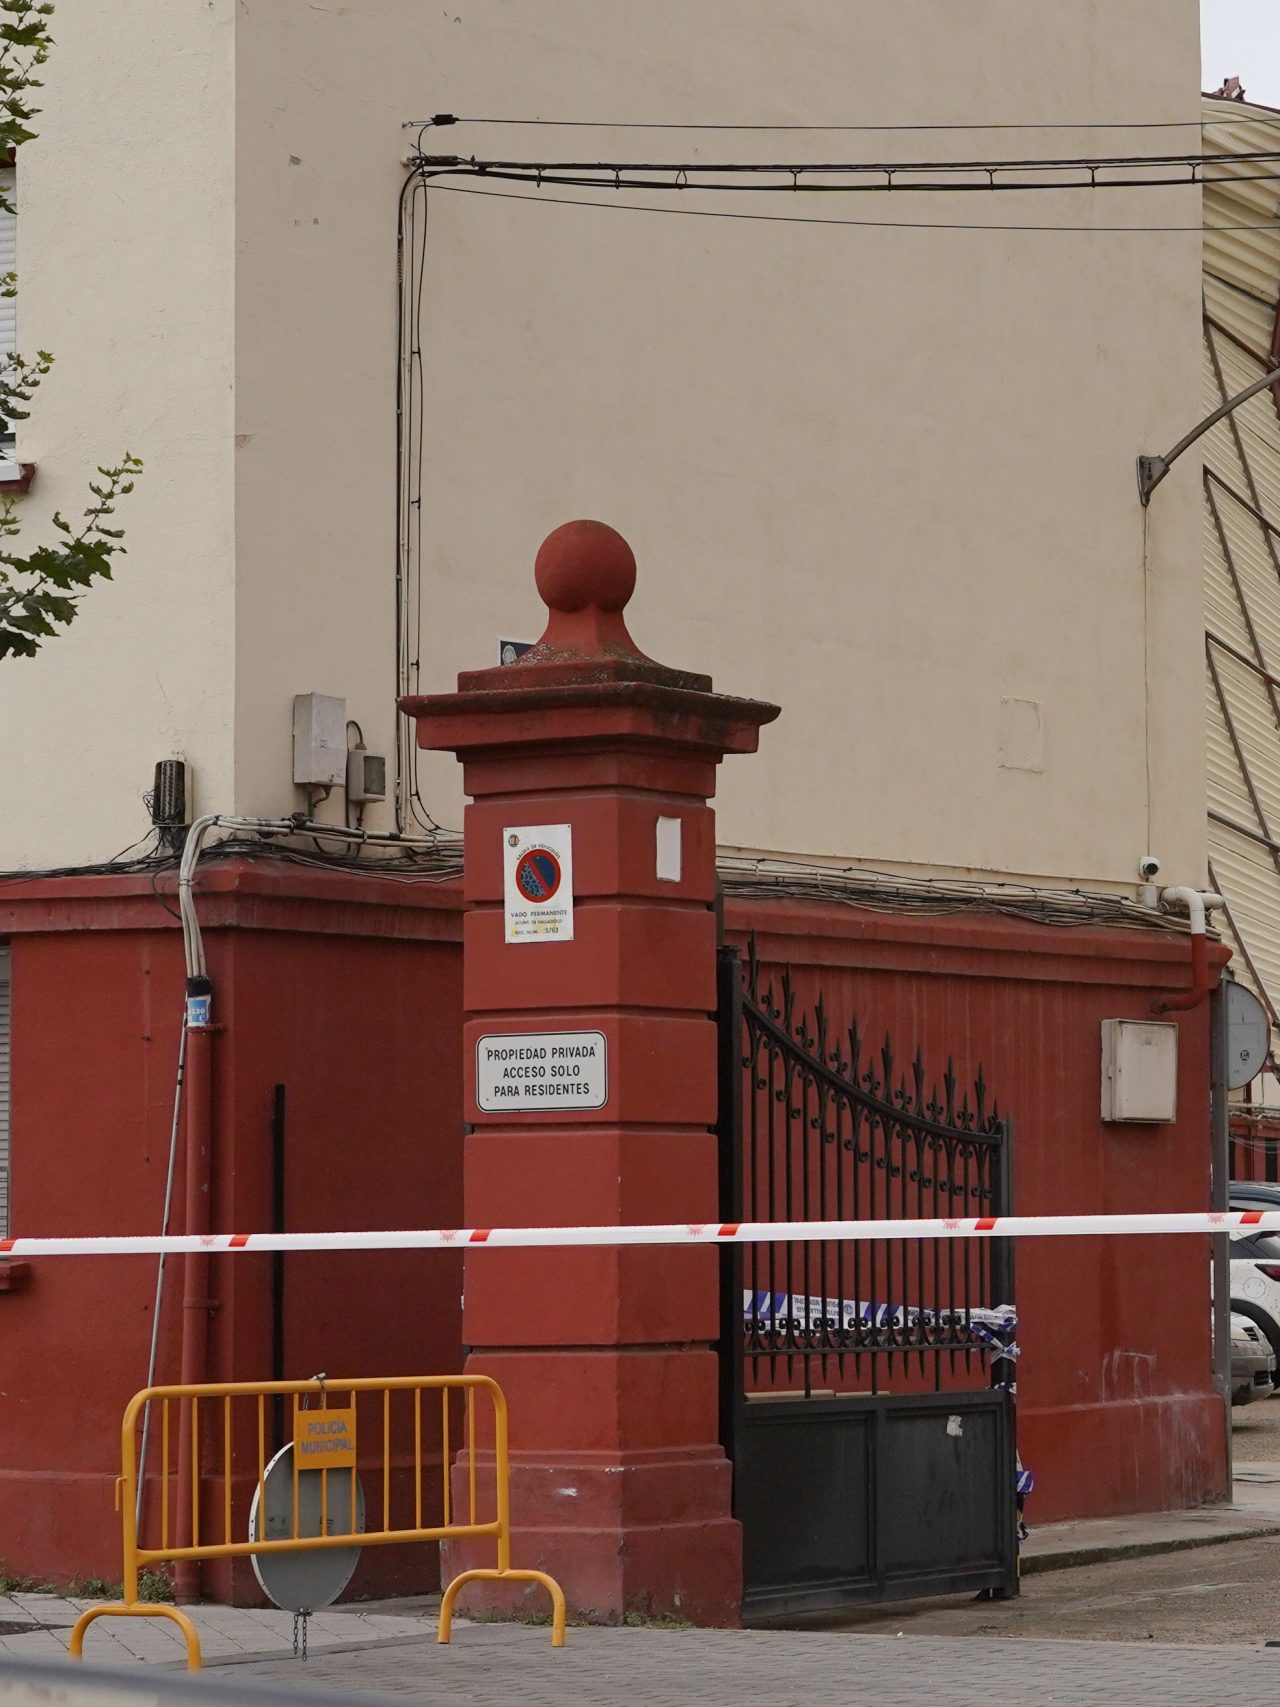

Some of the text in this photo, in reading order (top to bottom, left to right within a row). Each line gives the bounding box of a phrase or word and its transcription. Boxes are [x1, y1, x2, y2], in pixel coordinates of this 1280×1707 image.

[530, 909, 568, 917] PERMANENTE
[487, 1046, 596, 1061] PROPIEDAD PRIVADA
[503, 1065, 580, 1079] ACCESO SOLO
[494, 1083, 590, 1097] PARA RESIDENTES
[301, 1438, 353, 1454] MUNICIPAL
